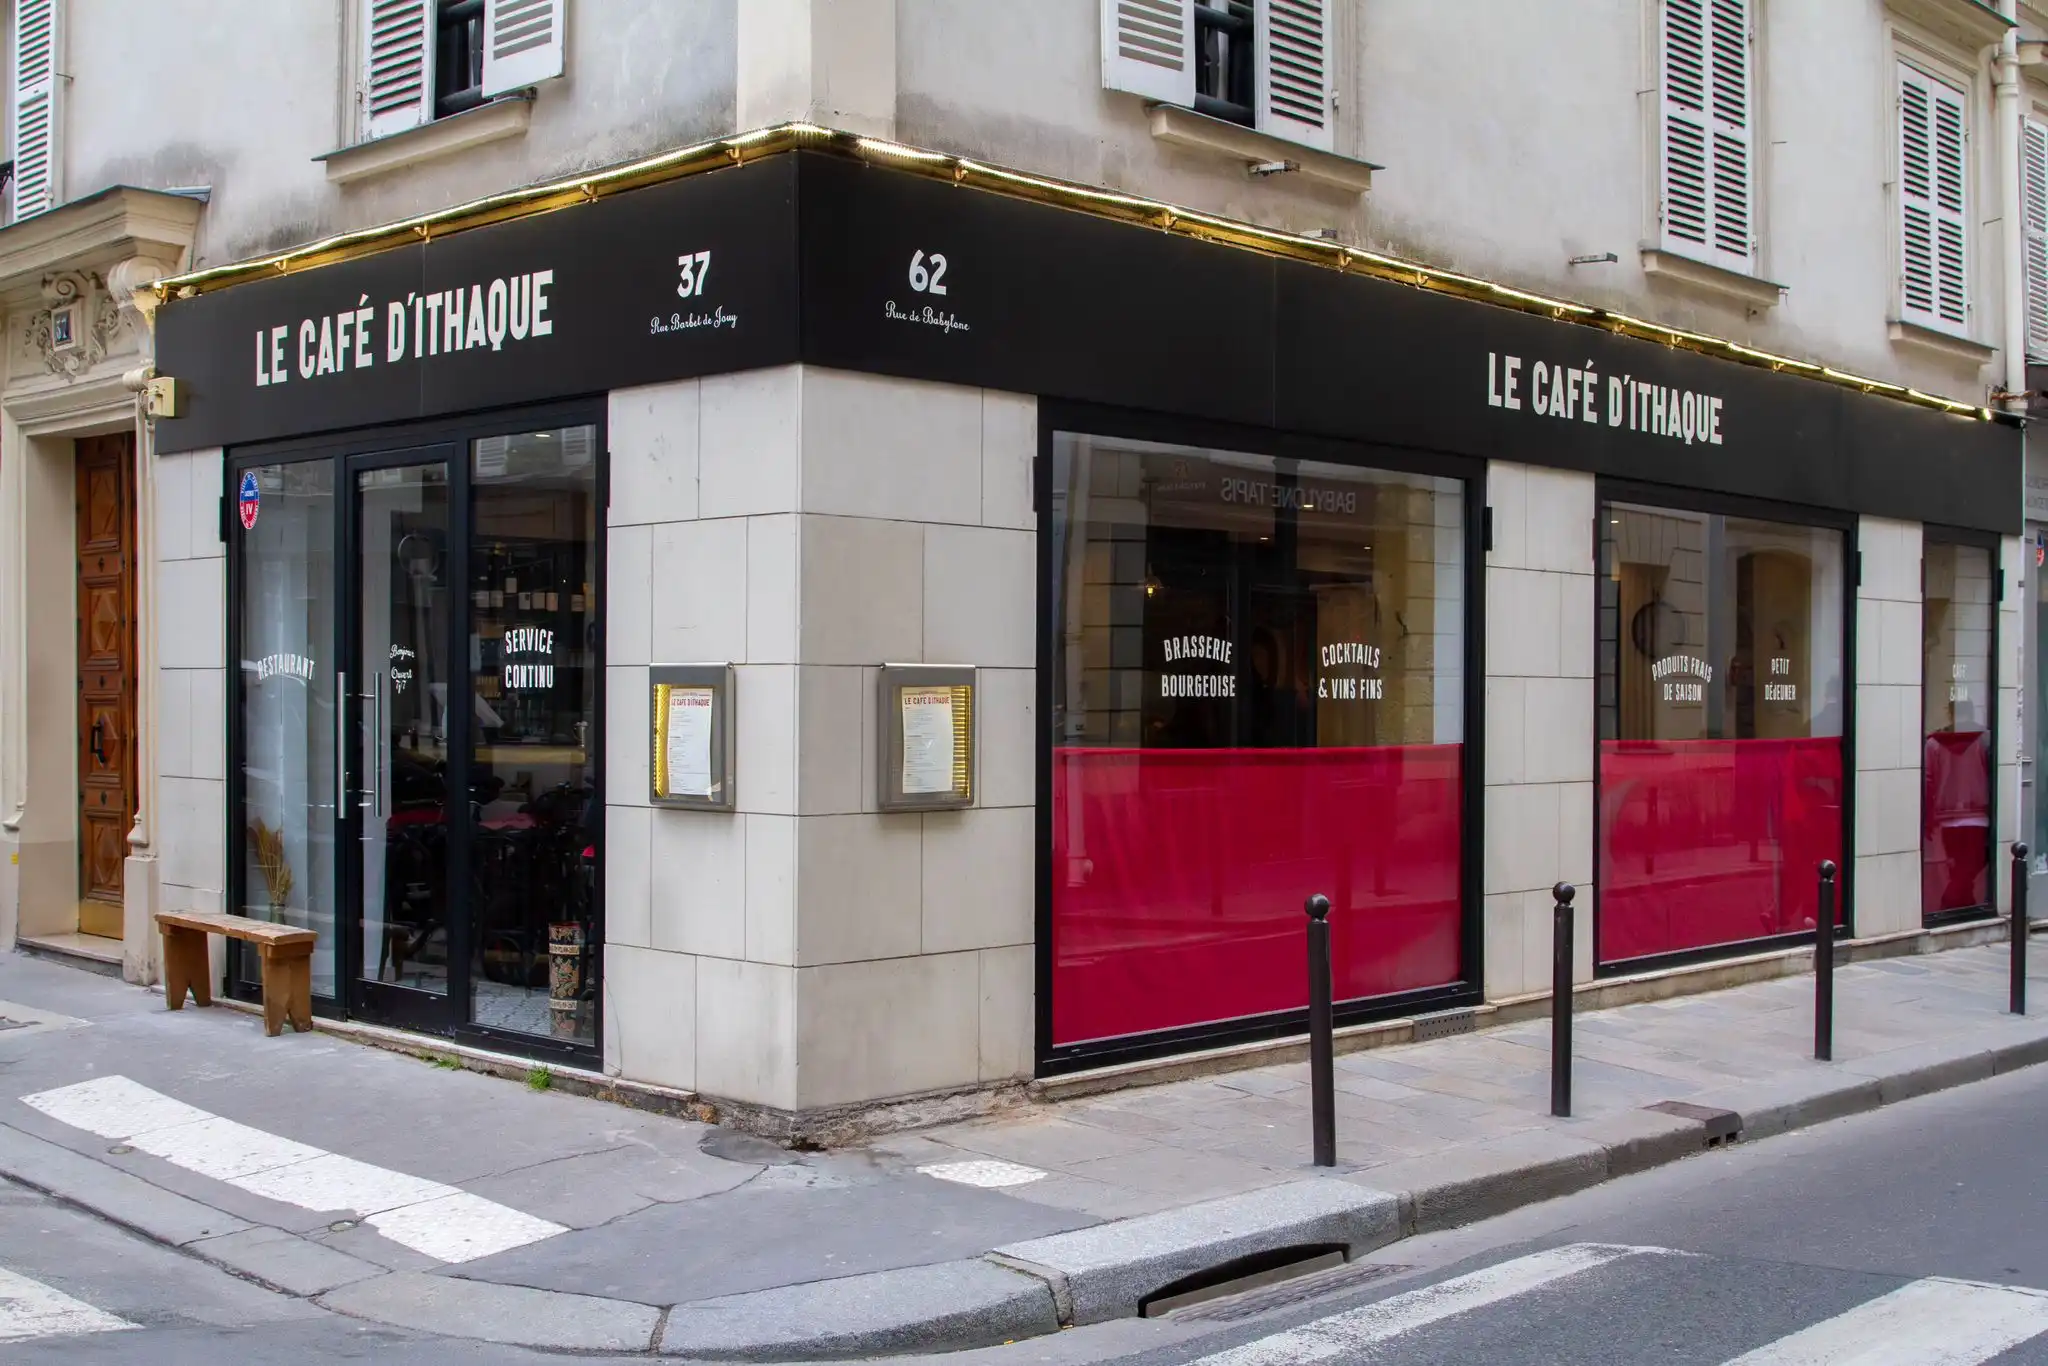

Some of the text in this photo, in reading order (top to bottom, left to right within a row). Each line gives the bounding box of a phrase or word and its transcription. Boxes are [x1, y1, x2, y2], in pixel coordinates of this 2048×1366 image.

[677, 250, 711, 298] 37
[908, 249, 947, 296] 62
[256, 269, 554, 386] LE CAFÉ D'ITHAQUE
[650, 305, 738, 335] Rue Barbet de Jouy
[885, 300, 970, 334] Rue de Babylone
[1488, 351, 1723, 445] LE CAFÉ D'ITHAQUE
[505, 628, 554, 655] SERVICE
[1163, 635, 1233, 664] BRASSERIE
[1321, 642, 1380, 669] COCKTAILS
[257, 653, 315, 681] RESTAURANT
[505, 664, 554, 689] CONTINU
[1652, 655, 1713, 683] PRODUITS FRAIS
[1771, 658, 1790, 675] PETIT
[1161, 674, 1236, 698] BOURGEOISE
[1317, 677, 1383, 700] & VINS FINS
[1663, 683, 1702, 702] DE SAISON
[1764, 681, 1796, 701] DÉJEUNER
